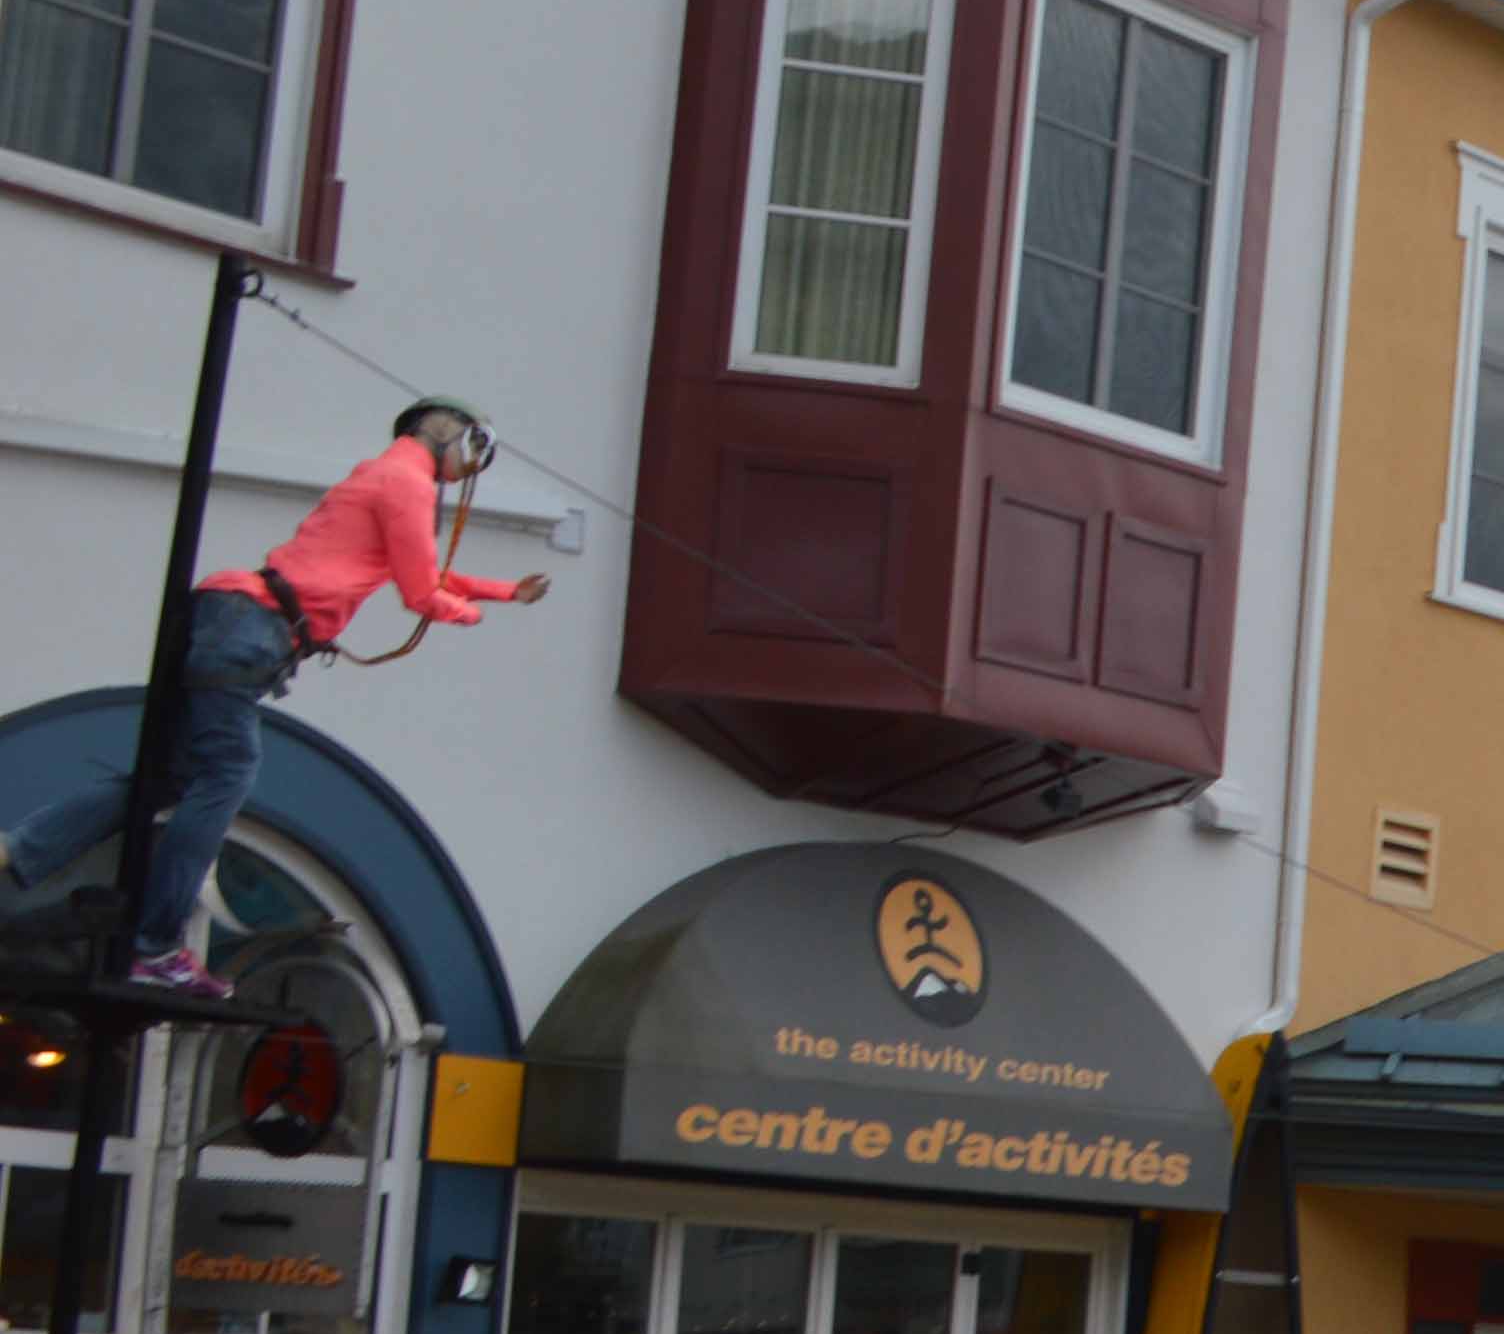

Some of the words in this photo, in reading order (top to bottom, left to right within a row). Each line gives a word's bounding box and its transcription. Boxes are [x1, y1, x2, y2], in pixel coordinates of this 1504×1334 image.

[775, 1028, 838, 1059] the
[849, 1039, 987, 1083] activity
[996, 1056, 1110, 1091] center
[675, 1102, 893, 1159] centre
[904, 1117, 1192, 1187] d'activités
